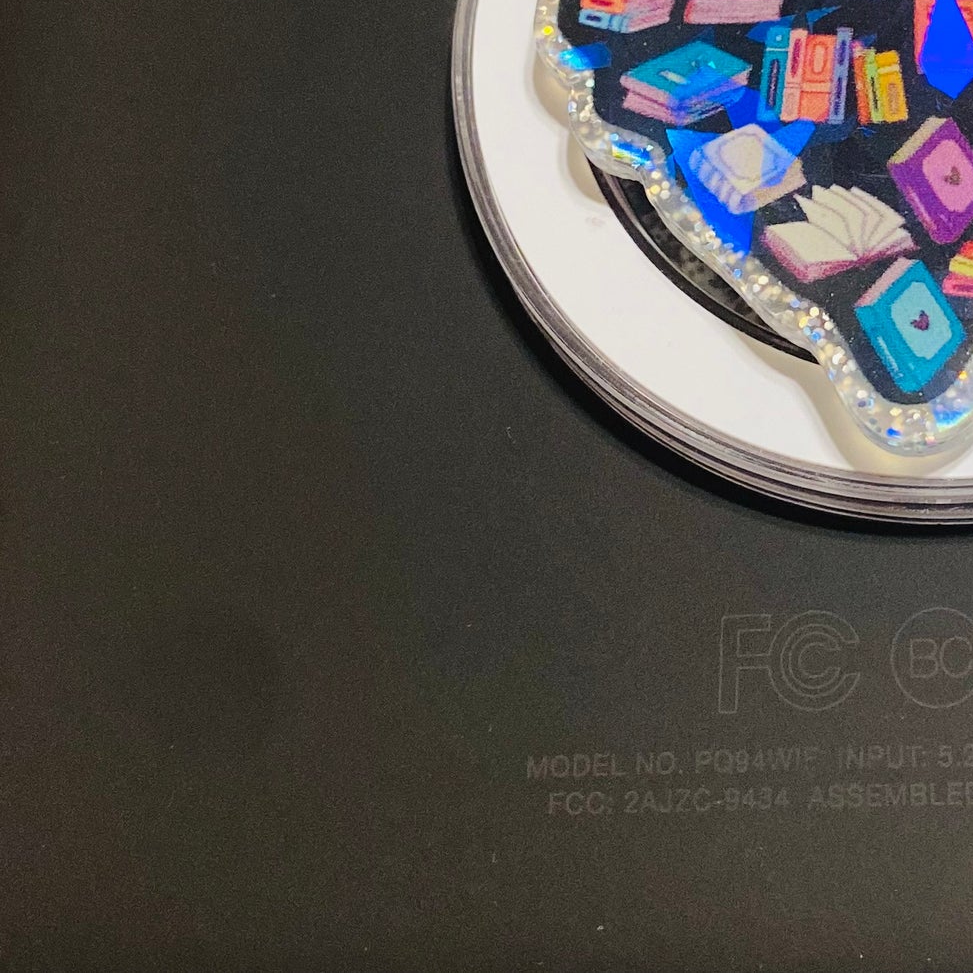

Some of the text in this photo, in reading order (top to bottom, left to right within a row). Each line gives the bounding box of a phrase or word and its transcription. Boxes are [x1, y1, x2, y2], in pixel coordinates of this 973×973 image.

[909, 636, 973, 678] BC
[526, 753, 626, 777] MODEL
[636, 751, 684, 775] NO.
